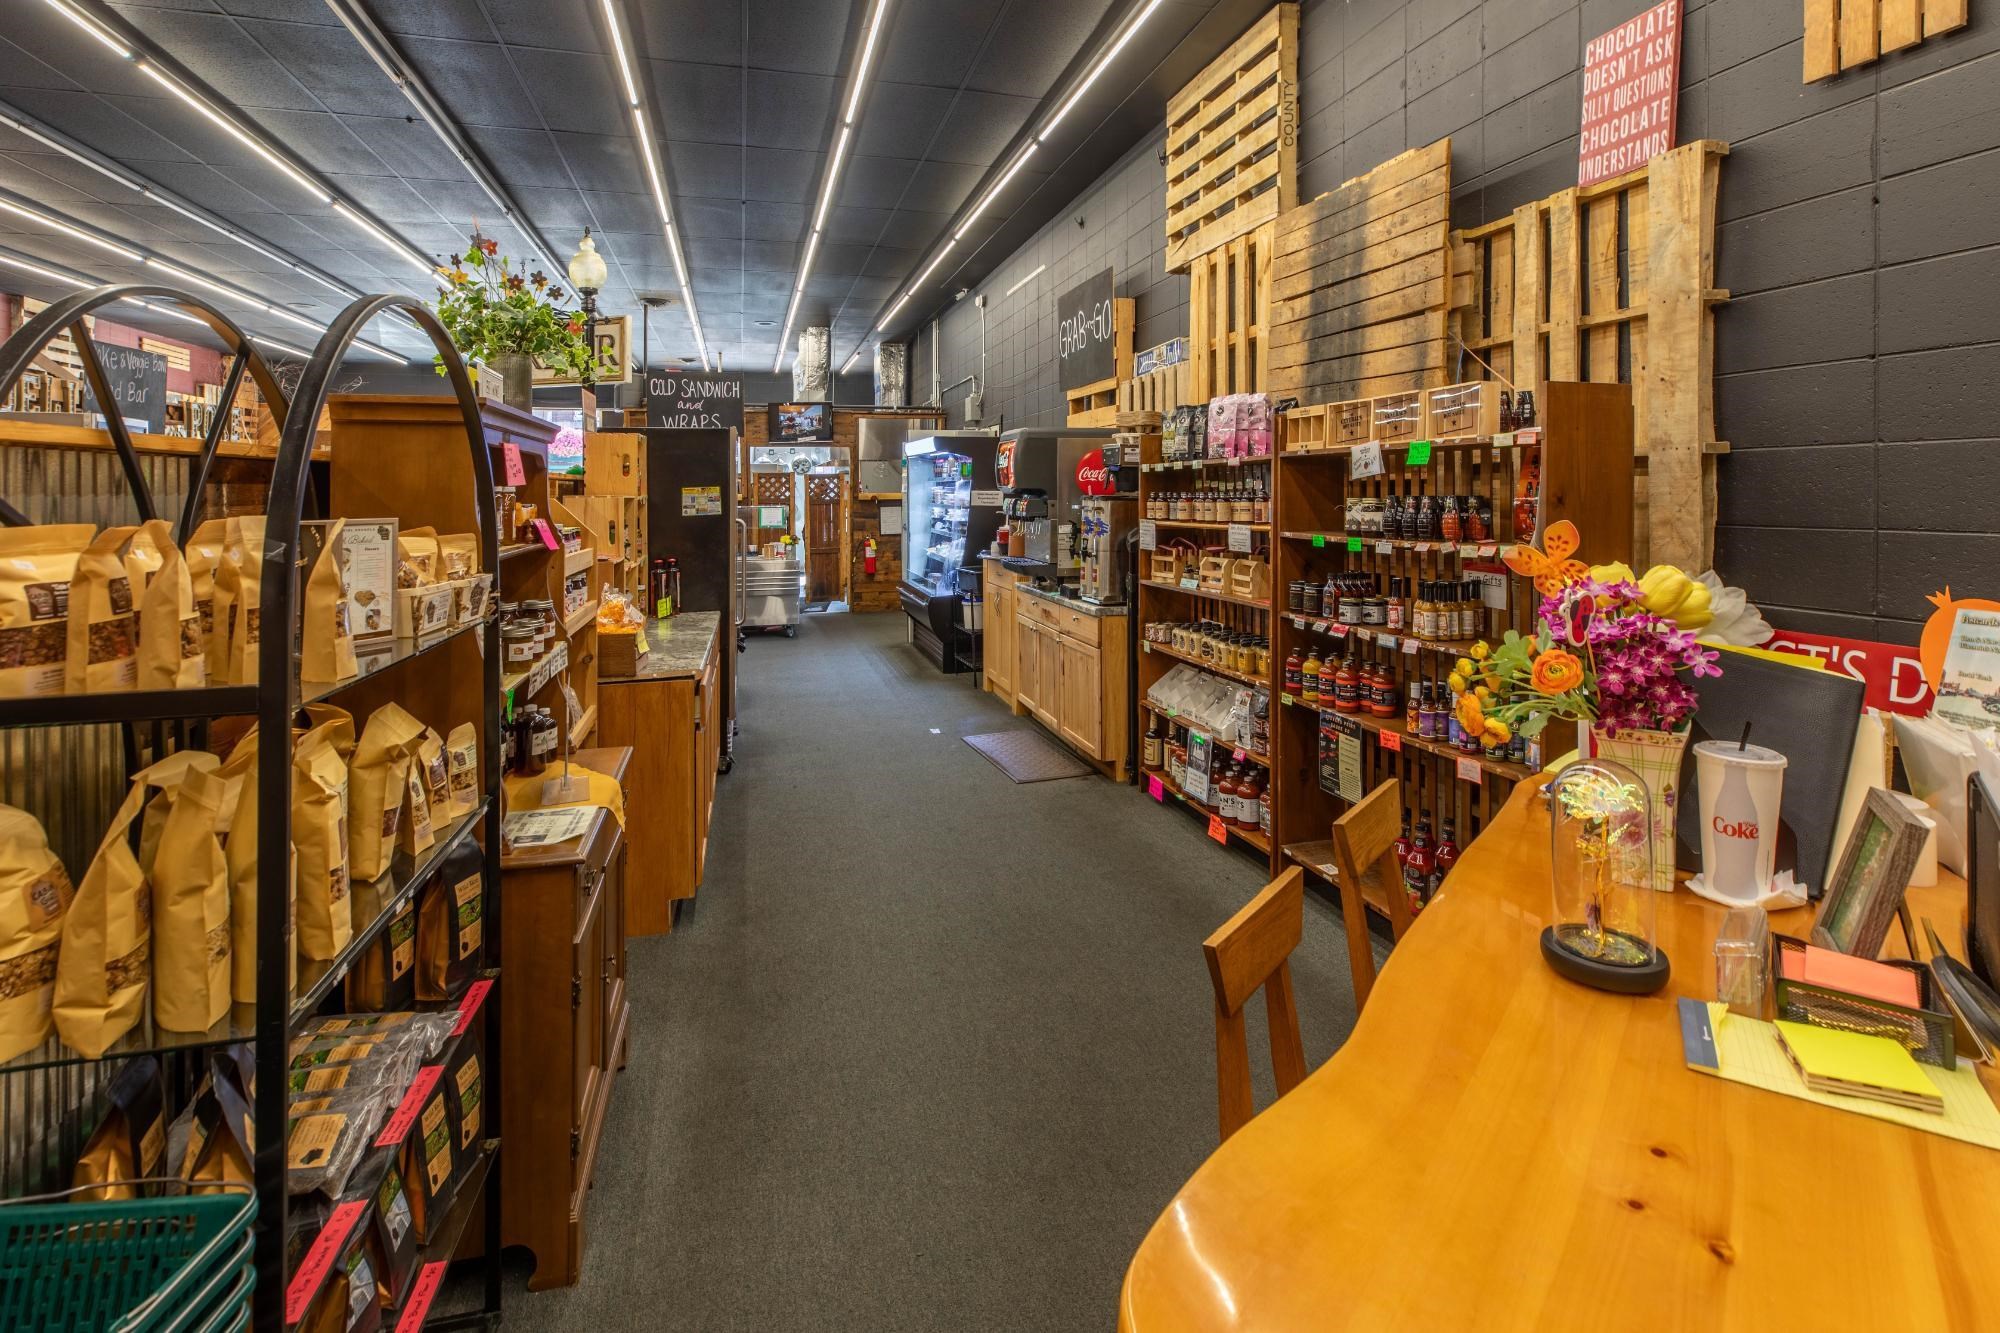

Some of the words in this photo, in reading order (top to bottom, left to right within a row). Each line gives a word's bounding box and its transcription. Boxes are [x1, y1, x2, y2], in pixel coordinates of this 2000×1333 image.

[1585, 1, 1676, 67] CHOCOLATE
[1584, 48, 1641, 96] DOESN'T
[1645, 32, 1674, 67] ASK
[1582, 91, 1610, 125] SILLY
[1613, 64, 1672, 112] QUESTIONS
[1283, 79, 1294, 147] COUNTY
[1580, 96, 1670, 155] CHOCOLATE
[1578, 130, 1669, 184] UNDERSTANDS
[128, 381, 149, 403] Bar
[650, 378, 676, 396] COLD
[681, 379, 740, 399] SANDWICH
[677, 399, 704, 410] and
[662, 413, 722, 429] WRAPS
[1079, 466, 1114, 482] Coca-Ca
[1482, 574, 1502, 587] Gifts
[1713, 816, 1759, 839] Coke
